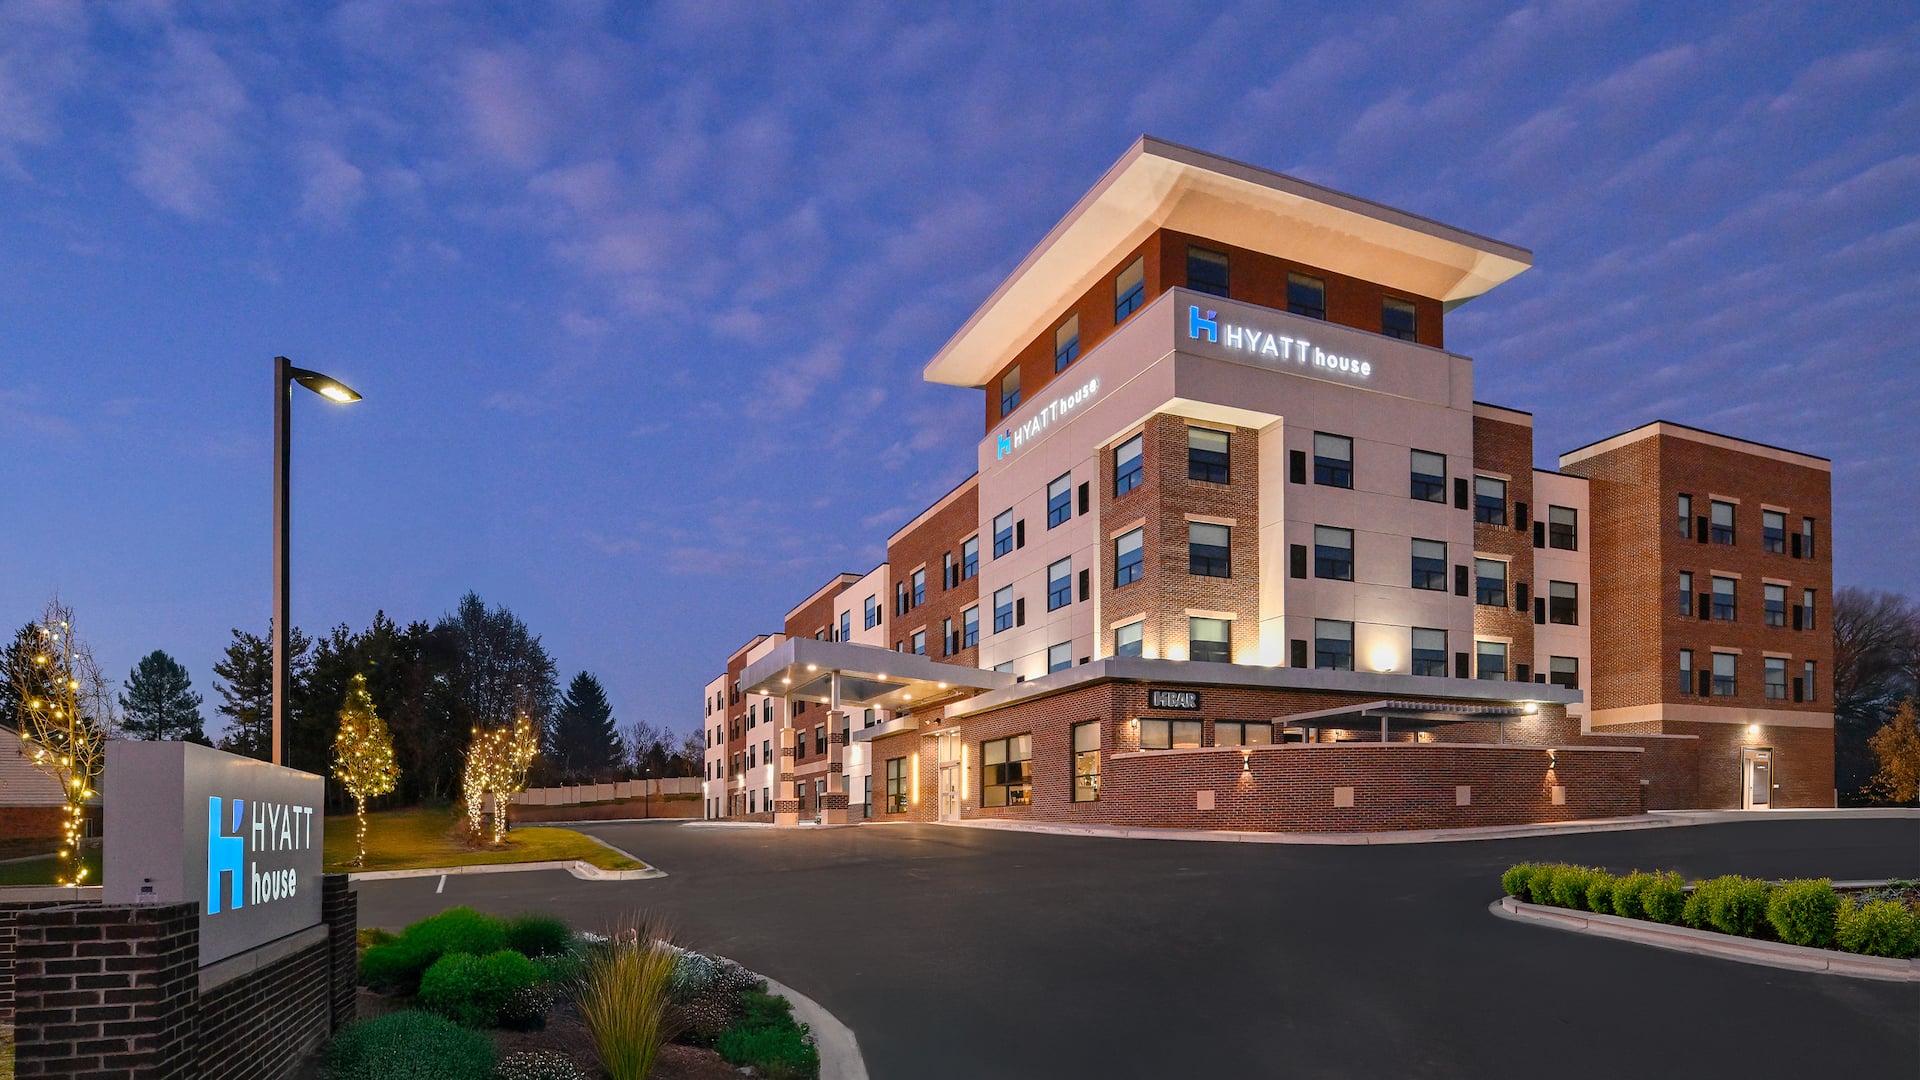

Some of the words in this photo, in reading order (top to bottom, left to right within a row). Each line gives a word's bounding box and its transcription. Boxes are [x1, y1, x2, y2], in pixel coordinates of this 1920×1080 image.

[1226, 324, 1310, 362] HYATT
[1315, 347, 1371, 376] house
[1014, 400, 1058, 448] HYATT
[1060, 379, 1097, 415] house
[252, 801, 313, 852] HYATT
[251, 861, 297, 905] house
